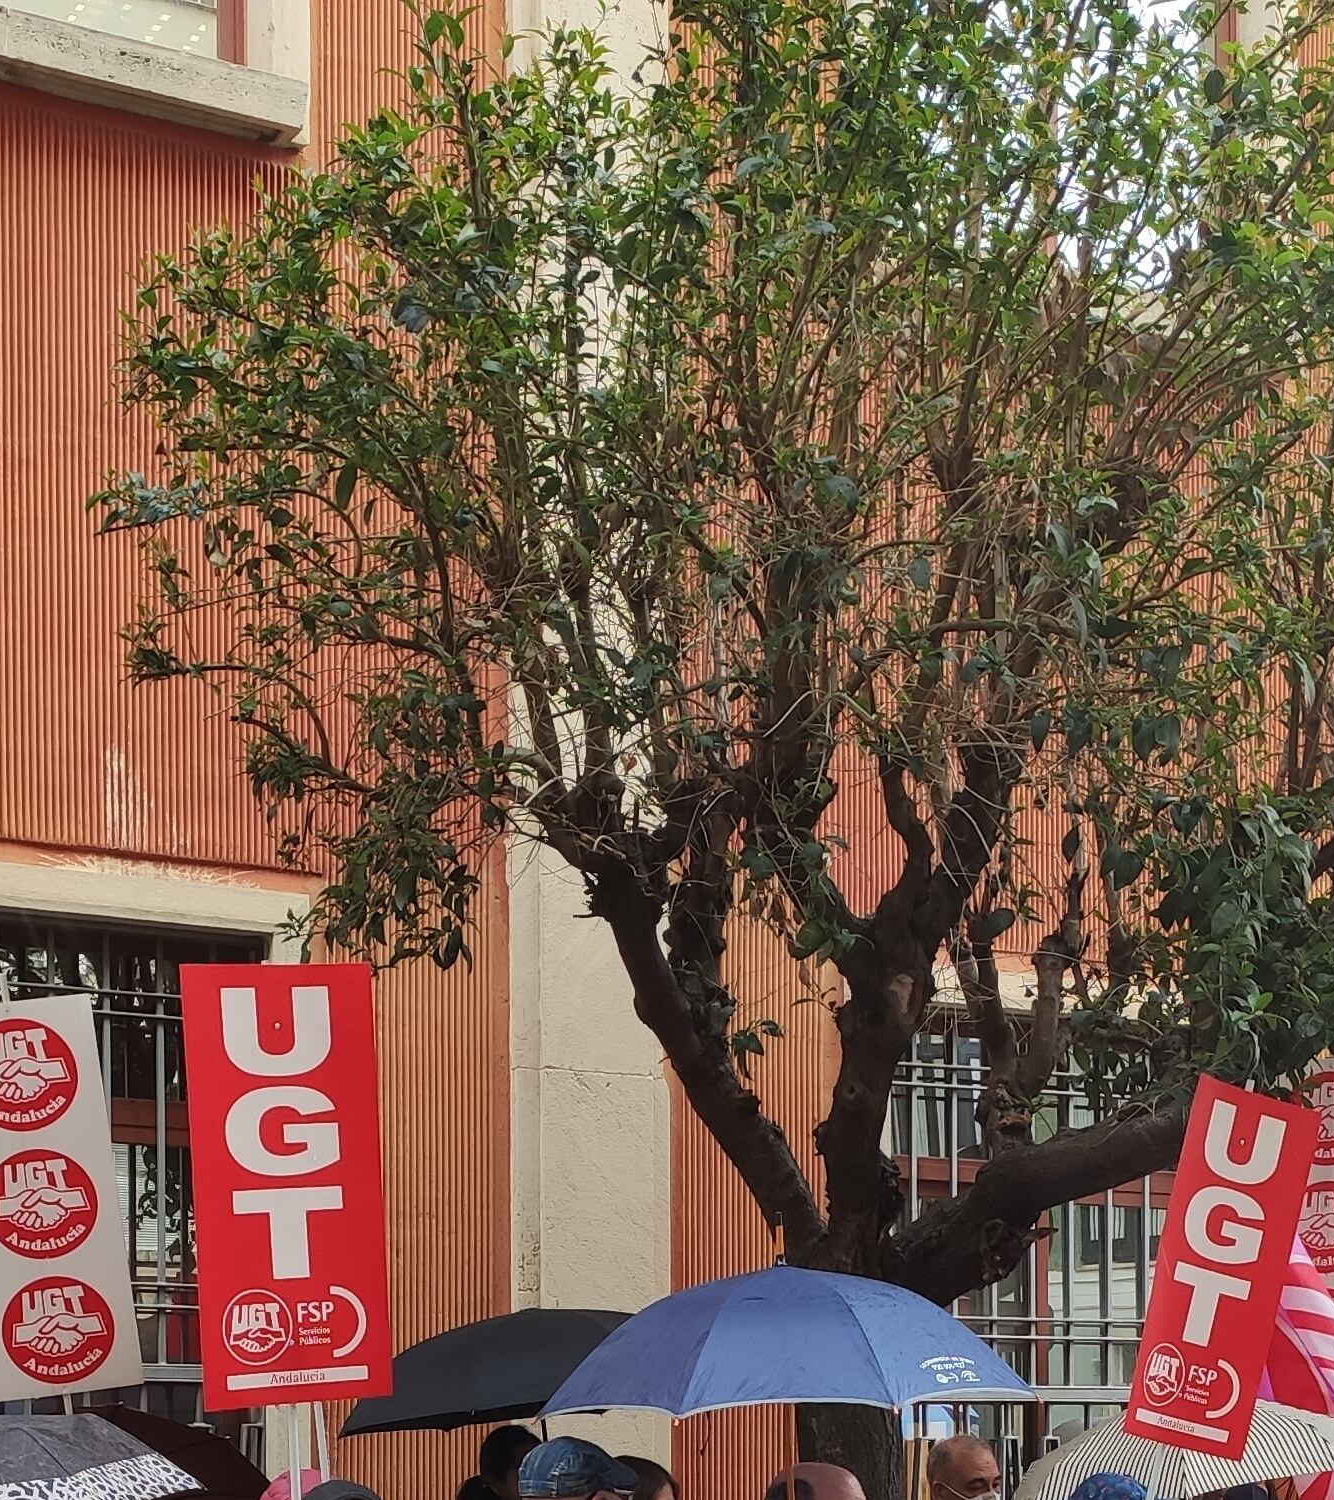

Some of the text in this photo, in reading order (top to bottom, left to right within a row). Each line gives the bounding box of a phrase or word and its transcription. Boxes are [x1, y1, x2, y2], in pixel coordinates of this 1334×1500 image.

[220, 986, 344, 1280] UGT
[2, 1158, 70, 1195] UGT
[4, 1219, 87, 1252] Andalucía
[1172, 1098, 1287, 1348] UGT
[20, 1284, 88, 1321] UGT
[231, 1303, 281, 1333] UGT
[296, 1301, 335, 1324] FSP
[298, 1326, 331, 1338] Servicios
[22, 1346, 103, 1378] Andalucía
[269, 1370, 326, 1385] Andalucía
[1149, 1351, 1180, 1382] UGT
[1187, 1364, 1218, 1387] FSP
[1156, 1415, 1195, 1433] Andalucía
